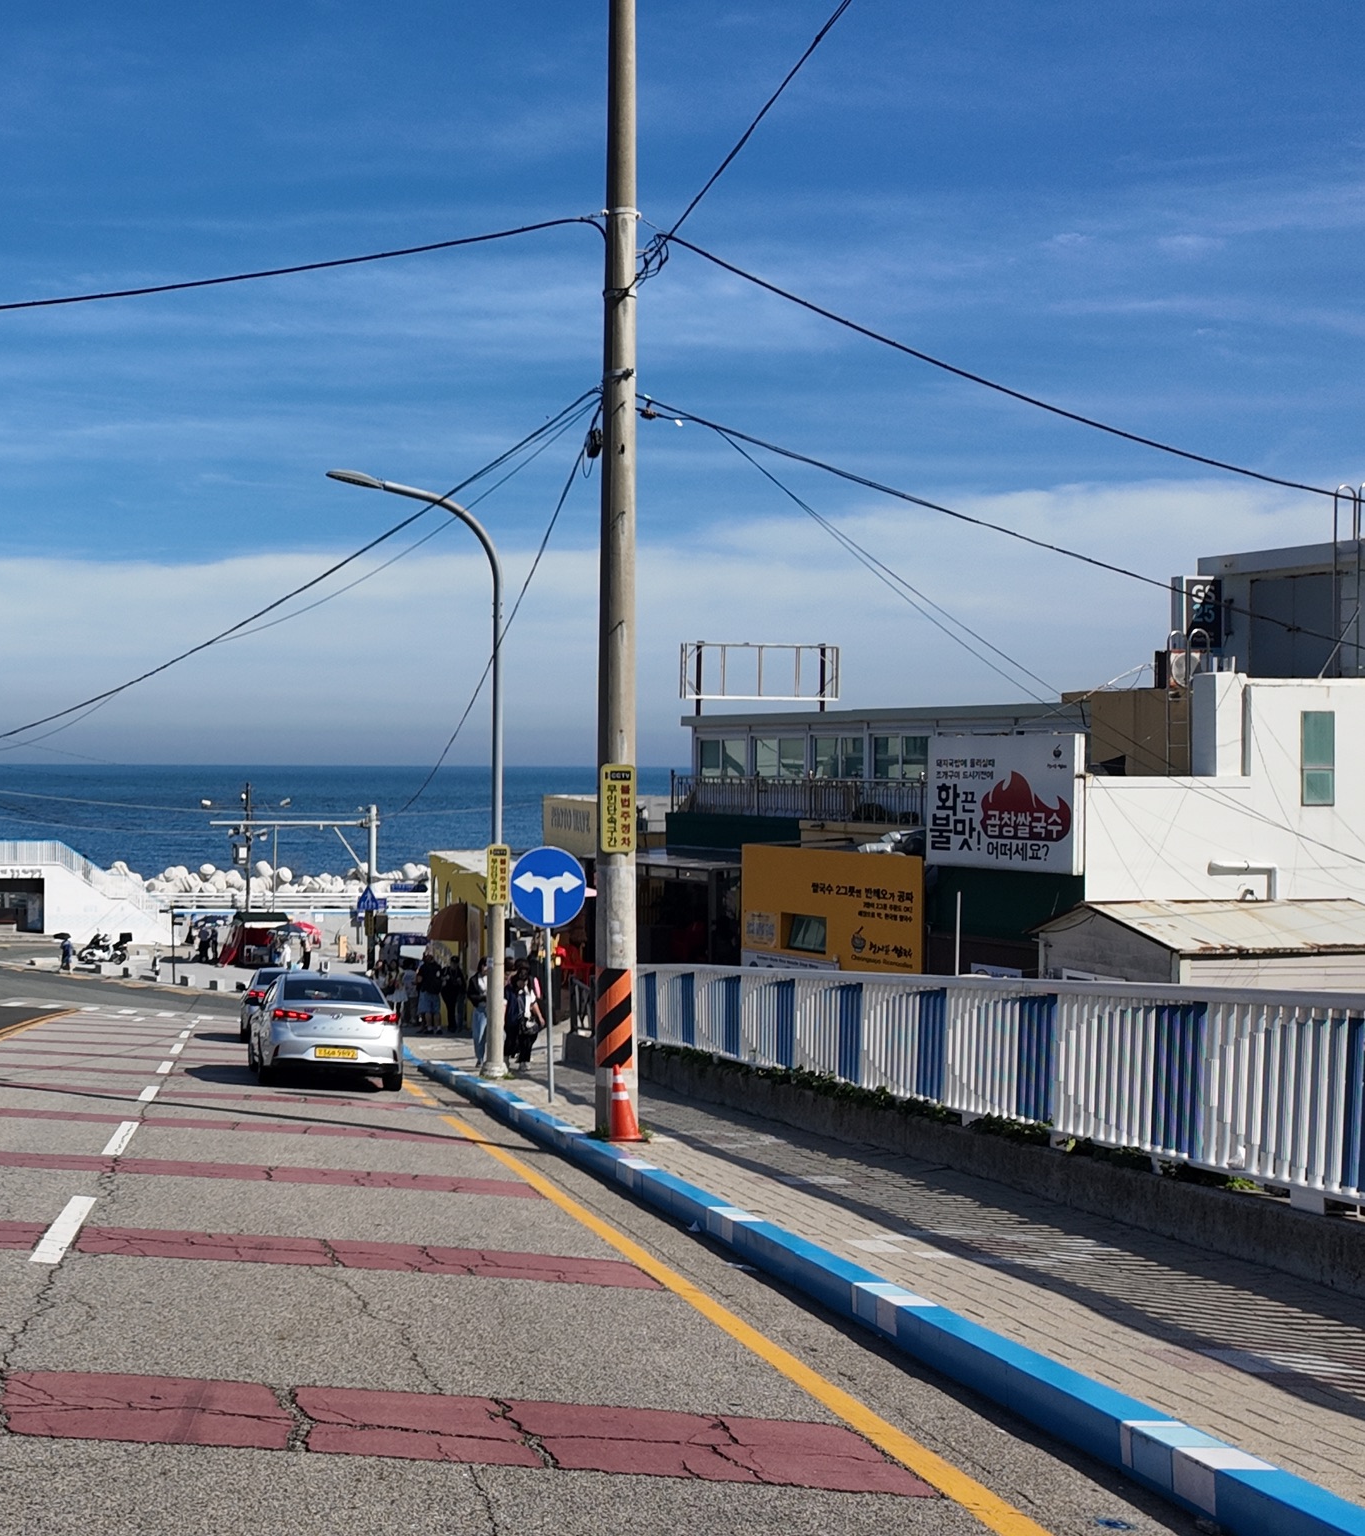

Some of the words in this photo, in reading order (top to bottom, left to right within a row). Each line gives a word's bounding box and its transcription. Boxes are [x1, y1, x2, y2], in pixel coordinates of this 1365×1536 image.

[1191, 584, 1215, 604] GS
[1192, 603, 1216, 623] 25
[610, 772, 631, 780] CCTV
[936, 771, 960, 780] 조개구이
[936, 783, 977, 816] 화끈
[606, 784, 617, 848] 무인단속구간
[620, 784, 631, 848] 불법주정차
[986, 809, 1063, 839] 곱창쌀국수
[929, 813, 981, 851] 불맛!
[987, 841, 1050, 861] 어떠세요?
[811, 882, 834, 895] 쌀국수
